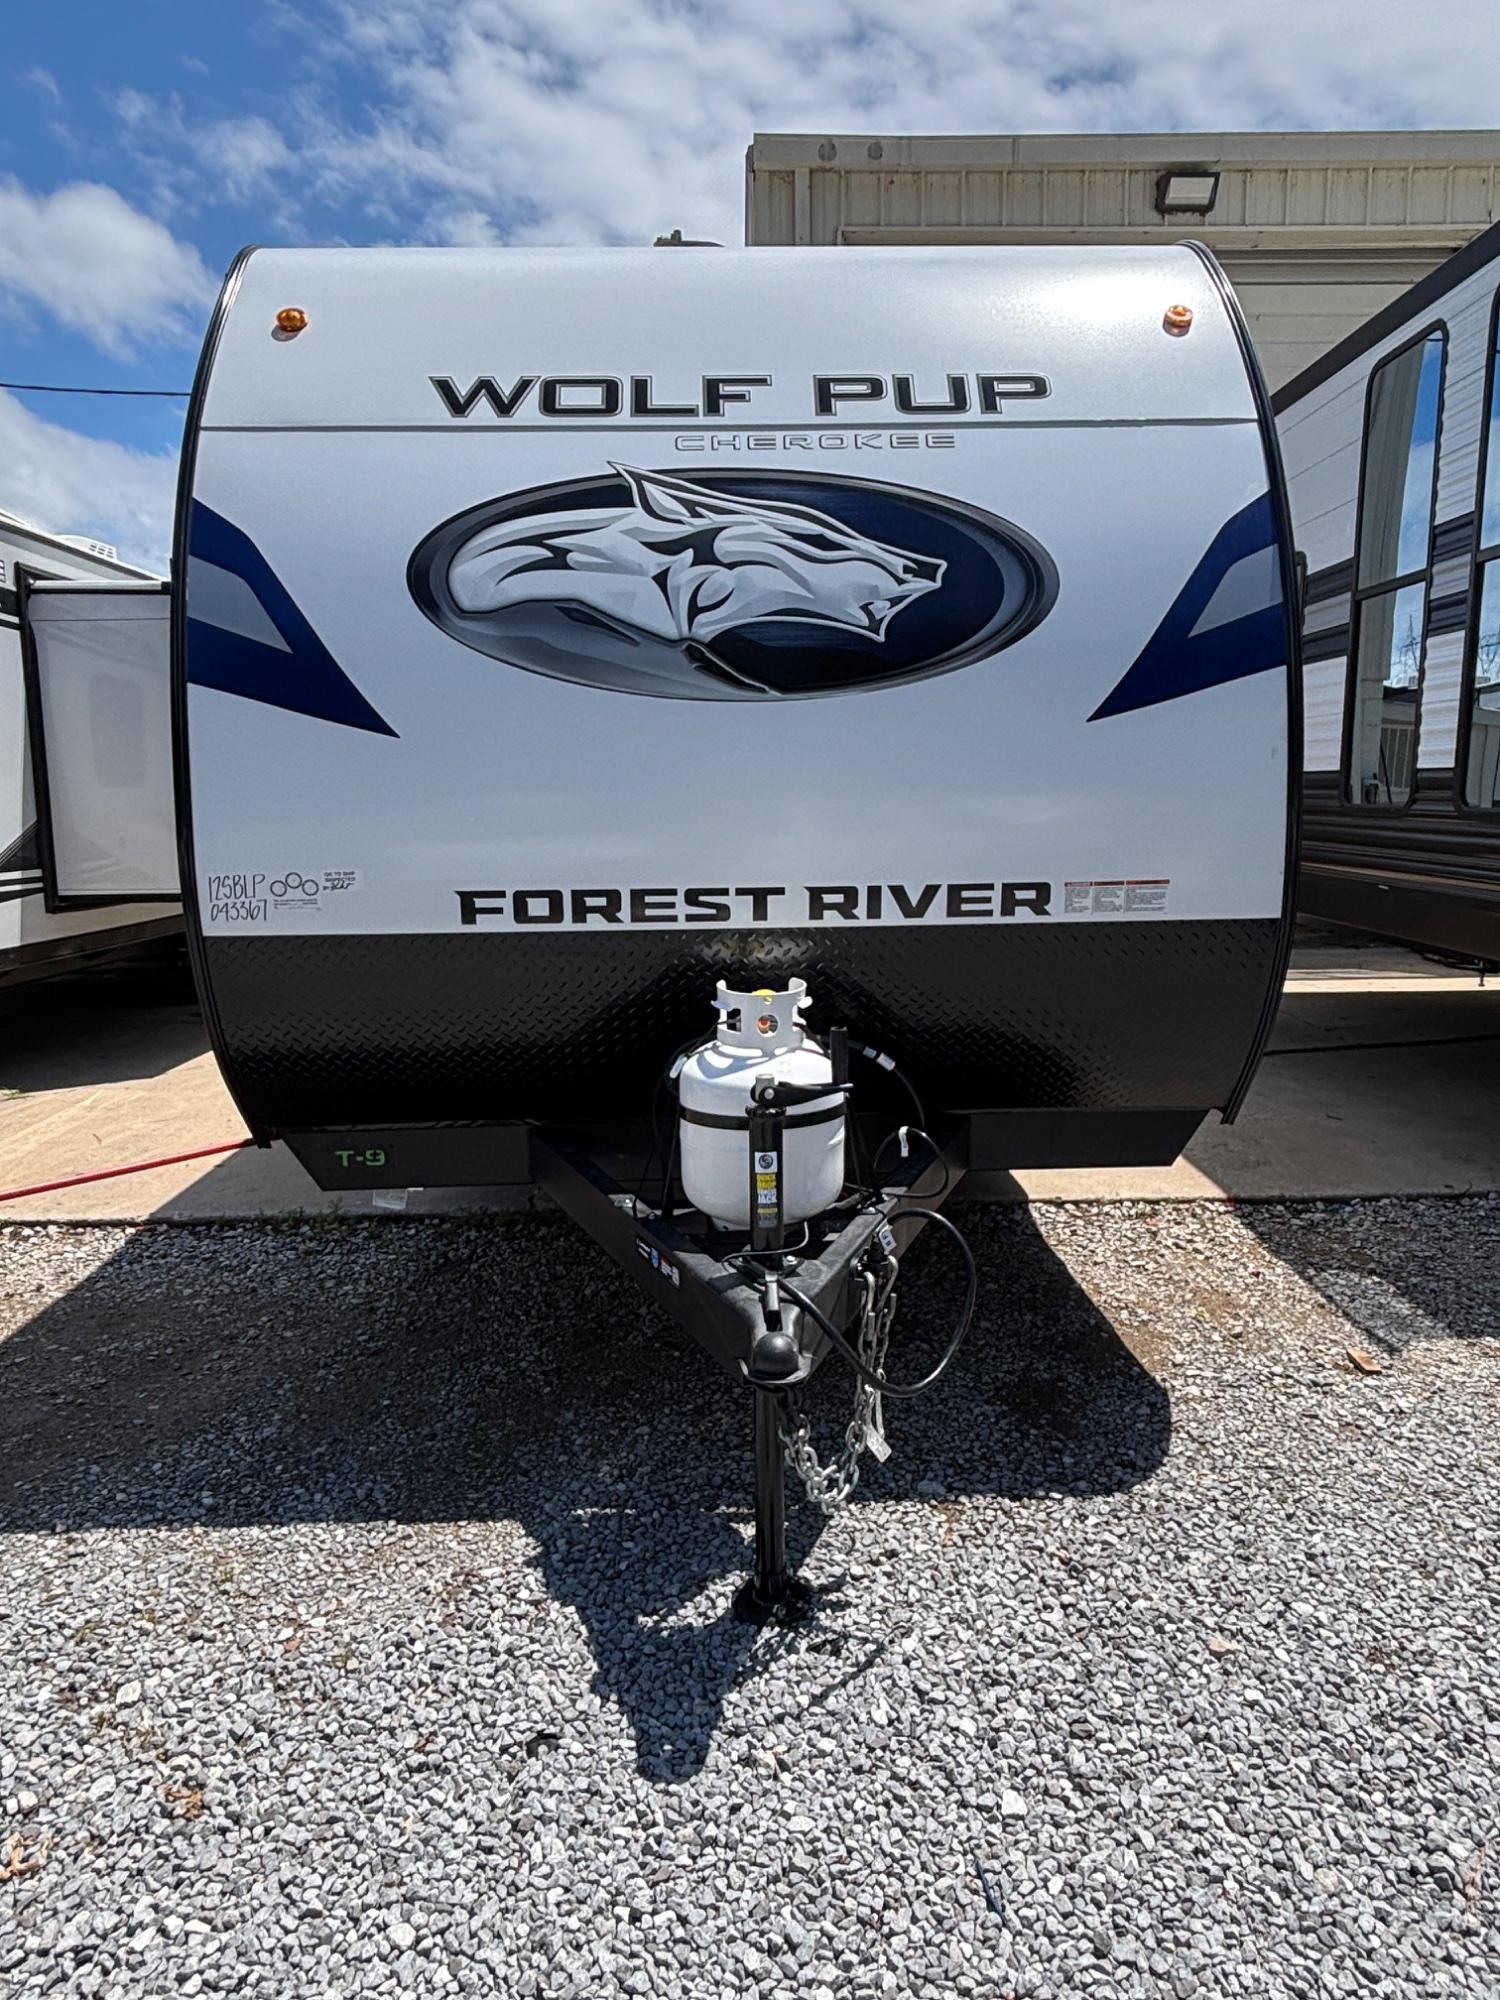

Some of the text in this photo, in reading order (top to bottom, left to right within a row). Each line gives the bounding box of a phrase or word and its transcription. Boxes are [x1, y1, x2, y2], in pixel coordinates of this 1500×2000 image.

[428, 373, 1052, 418] WOLF PUP
[674, 432, 955, 451] CHEROKEE
[210, 898, 268, 922] 043367
[454, 887, 786, 925] FOREST
[803, 882, 1052, 920] RIVER
[334, 1149, 386, 1167] T-9
